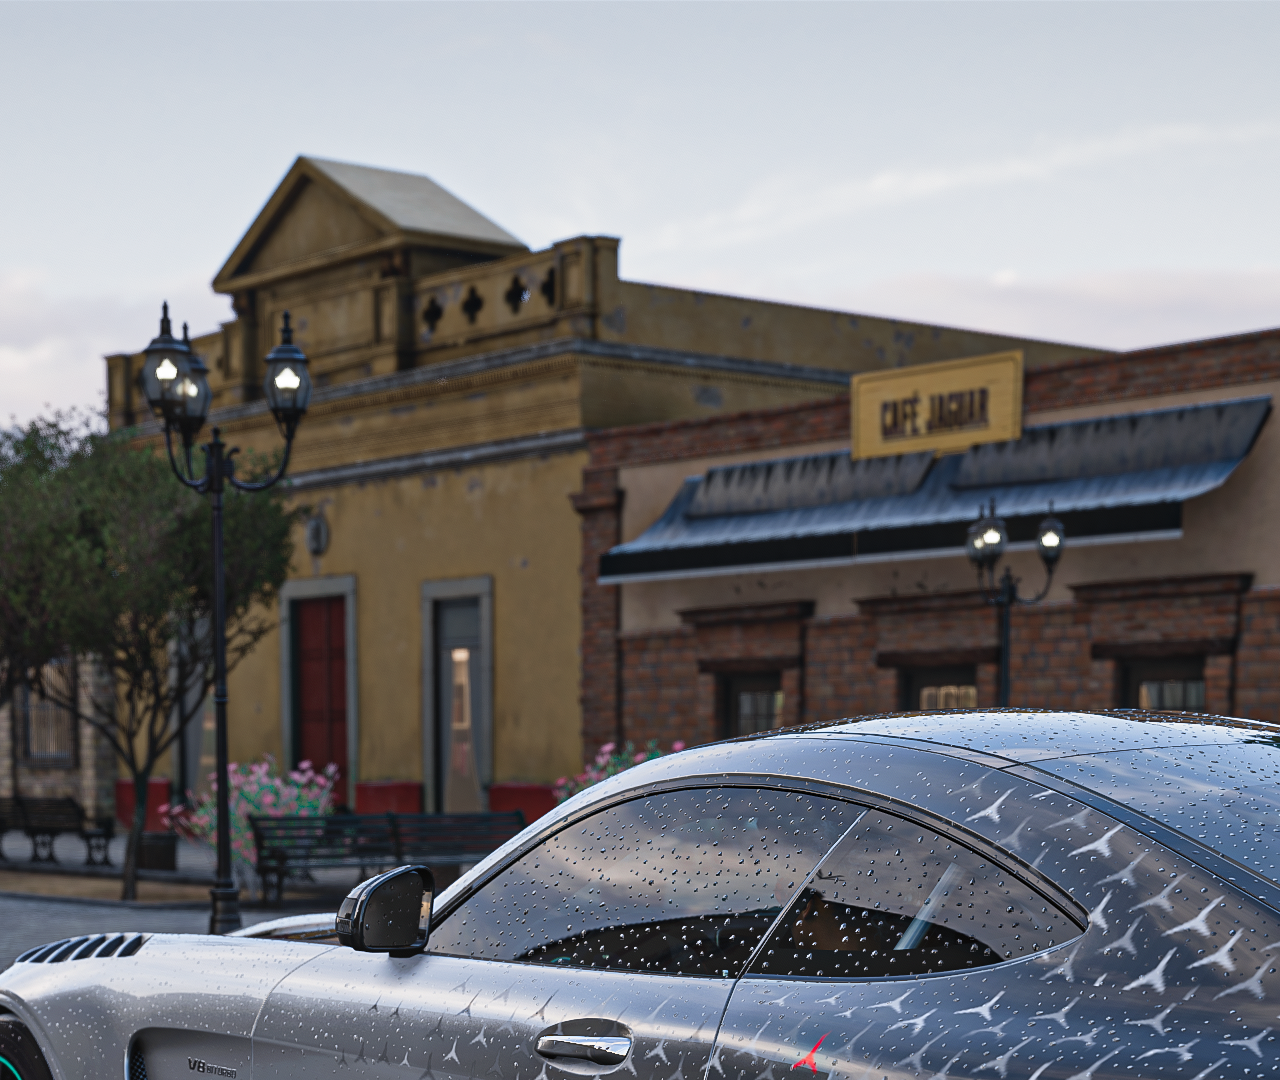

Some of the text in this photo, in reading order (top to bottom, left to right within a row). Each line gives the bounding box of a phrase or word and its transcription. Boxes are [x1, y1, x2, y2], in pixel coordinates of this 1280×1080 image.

[881, 387, 989, 440] CAFÉ JAGUAR
[188, 1057, 236, 1079] V8 BITURBO
